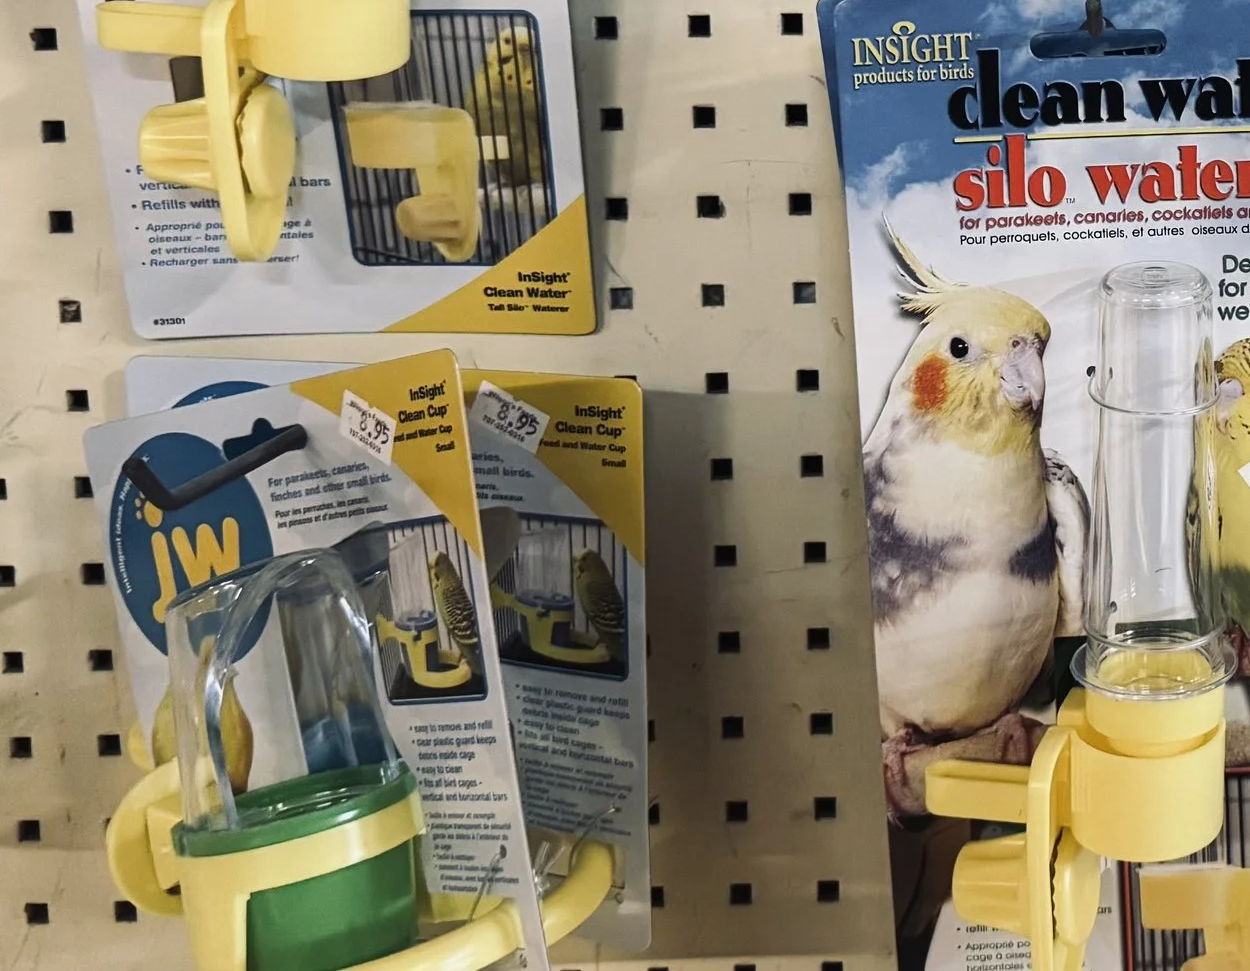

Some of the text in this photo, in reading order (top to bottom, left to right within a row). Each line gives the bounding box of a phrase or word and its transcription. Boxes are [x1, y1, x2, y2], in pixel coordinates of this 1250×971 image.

[851, 21, 972, 65] INSIGHT
[853, 63, 974, 89] products for birds
[947, 48, 1126, 130] clean
[300, 176, 331, 187] bars
[953, 134, 1066, 212] silo
[142, 197, 220, 211] Refills with
[146, 221, 201, 232] Approprié
[960, 216, 980, 230] for
[986, 211, 1070, 231] parakeets,
[1074, 209, 1149, 225] canaries,
[1152, 205, 1233, 221] cockatiels
[960, 234, 986, 245] Pour
[990, 231, 1059, 247] perroquets,
[1063, 227, 1128, 241] cockatiels,
[1132, 227, 1143, 237] et
[1147, 227, 1184, 237] autres
[1191, 224, 1238, 235] oiseaux
[150, 256, 238, 268] Recharger sans
[518, 272, 568, 285] InSight
[1218, 278, 1248, 297] for
[483, 287, 568, 298] Clean Water
[532, 304, 570, 312] Waterer
[409, 383, 446, 401] InSight
[398, 410, 425, 424] Clean
[427, 404, 447, 418] Cup
[497, 403, 540, 436] 8.95
[575, 405, 622, 421] InSight
[360, 410, 390, 444] 8.95
[555, 421, 622, 439] Clean Cup
[151, 500, 240, 624] jw
